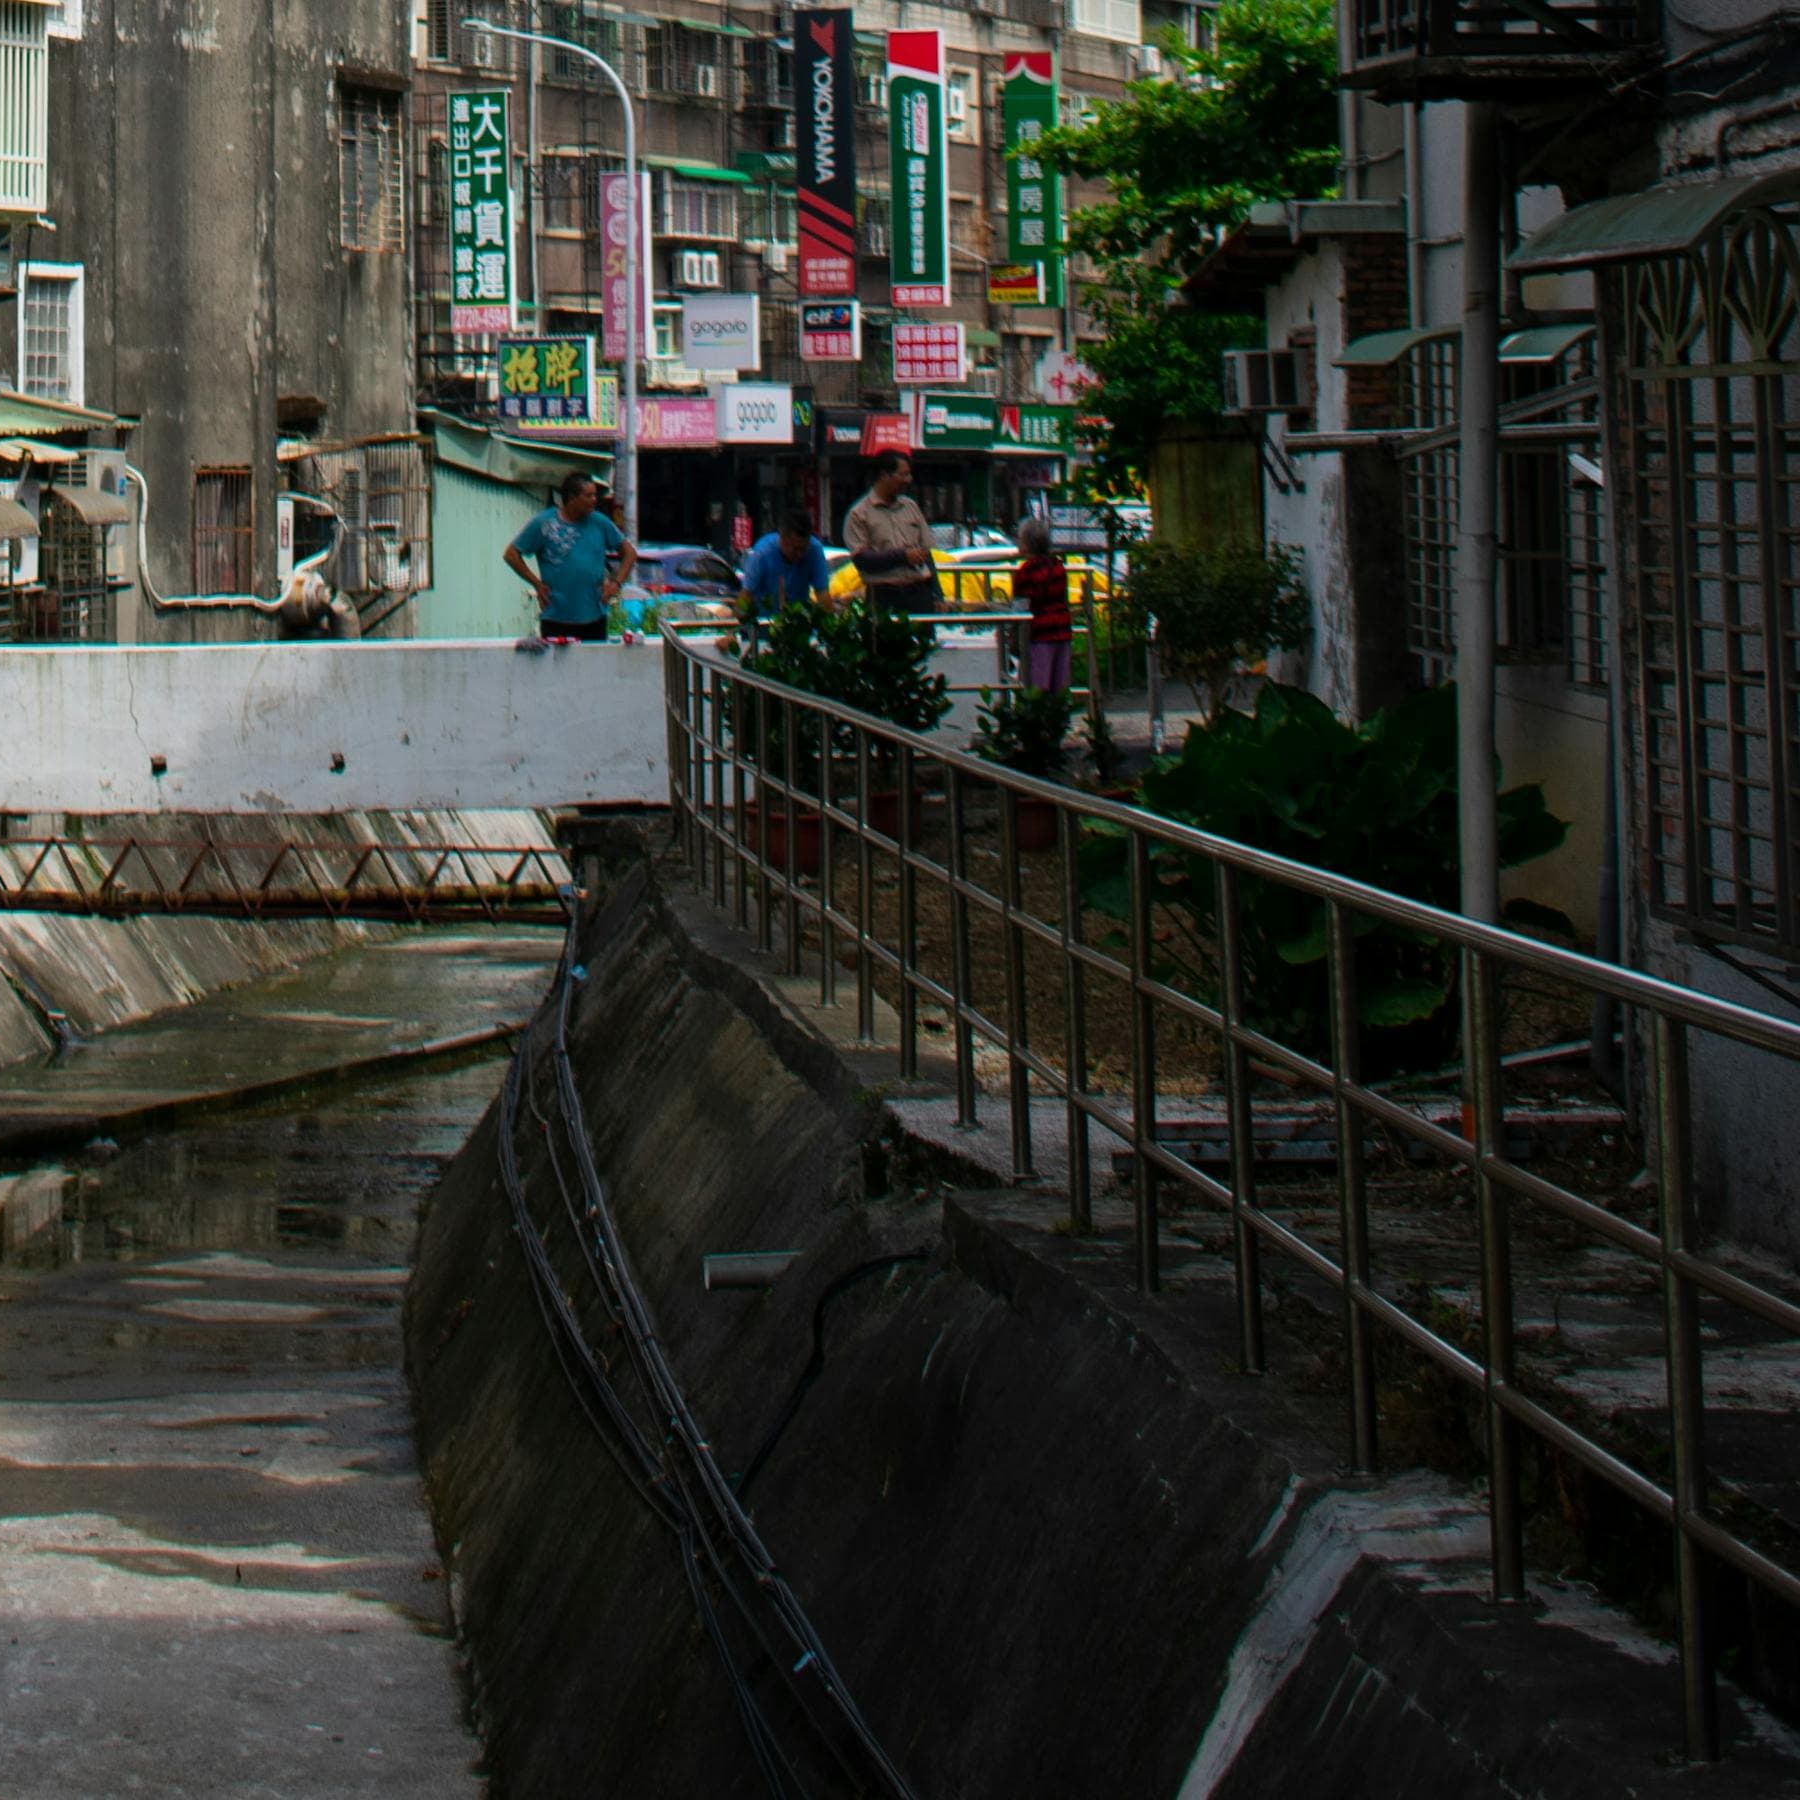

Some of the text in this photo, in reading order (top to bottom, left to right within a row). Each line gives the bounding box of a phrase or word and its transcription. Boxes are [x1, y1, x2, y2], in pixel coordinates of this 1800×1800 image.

[811, 56, 835, 184] YOKOHAMA
[472, 96, 506, 299] 大千貨運
[503, 342, 581, 398] 招牌
[690, 320, 748, 337] gogoro
